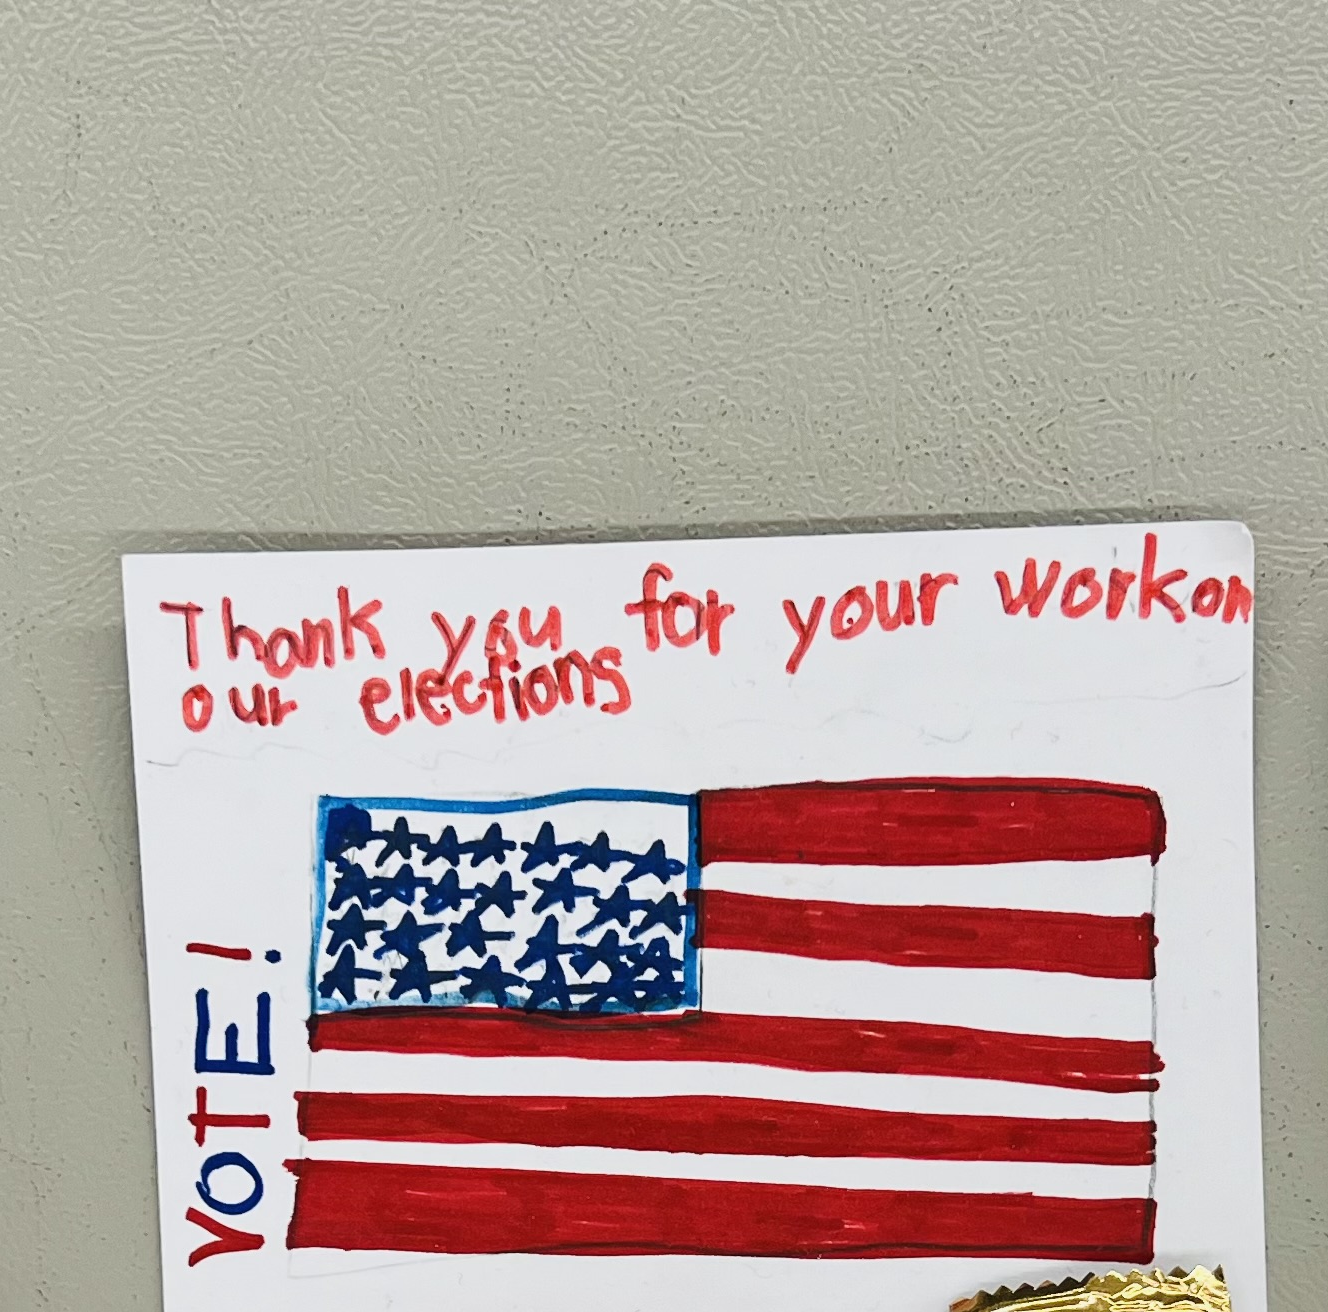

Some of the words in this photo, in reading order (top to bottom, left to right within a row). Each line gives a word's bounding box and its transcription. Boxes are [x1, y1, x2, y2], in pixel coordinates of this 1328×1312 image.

[159, 585, 387, 679] Thank
[431, 605, 562, 688] you
[624, 562, 735, 656] for
[782, 572, 959, 675] your
[181, 683, 298, 733] our
[359, 646, 632, 735] elections
[185, 942, 282, 1268] VOTE!
